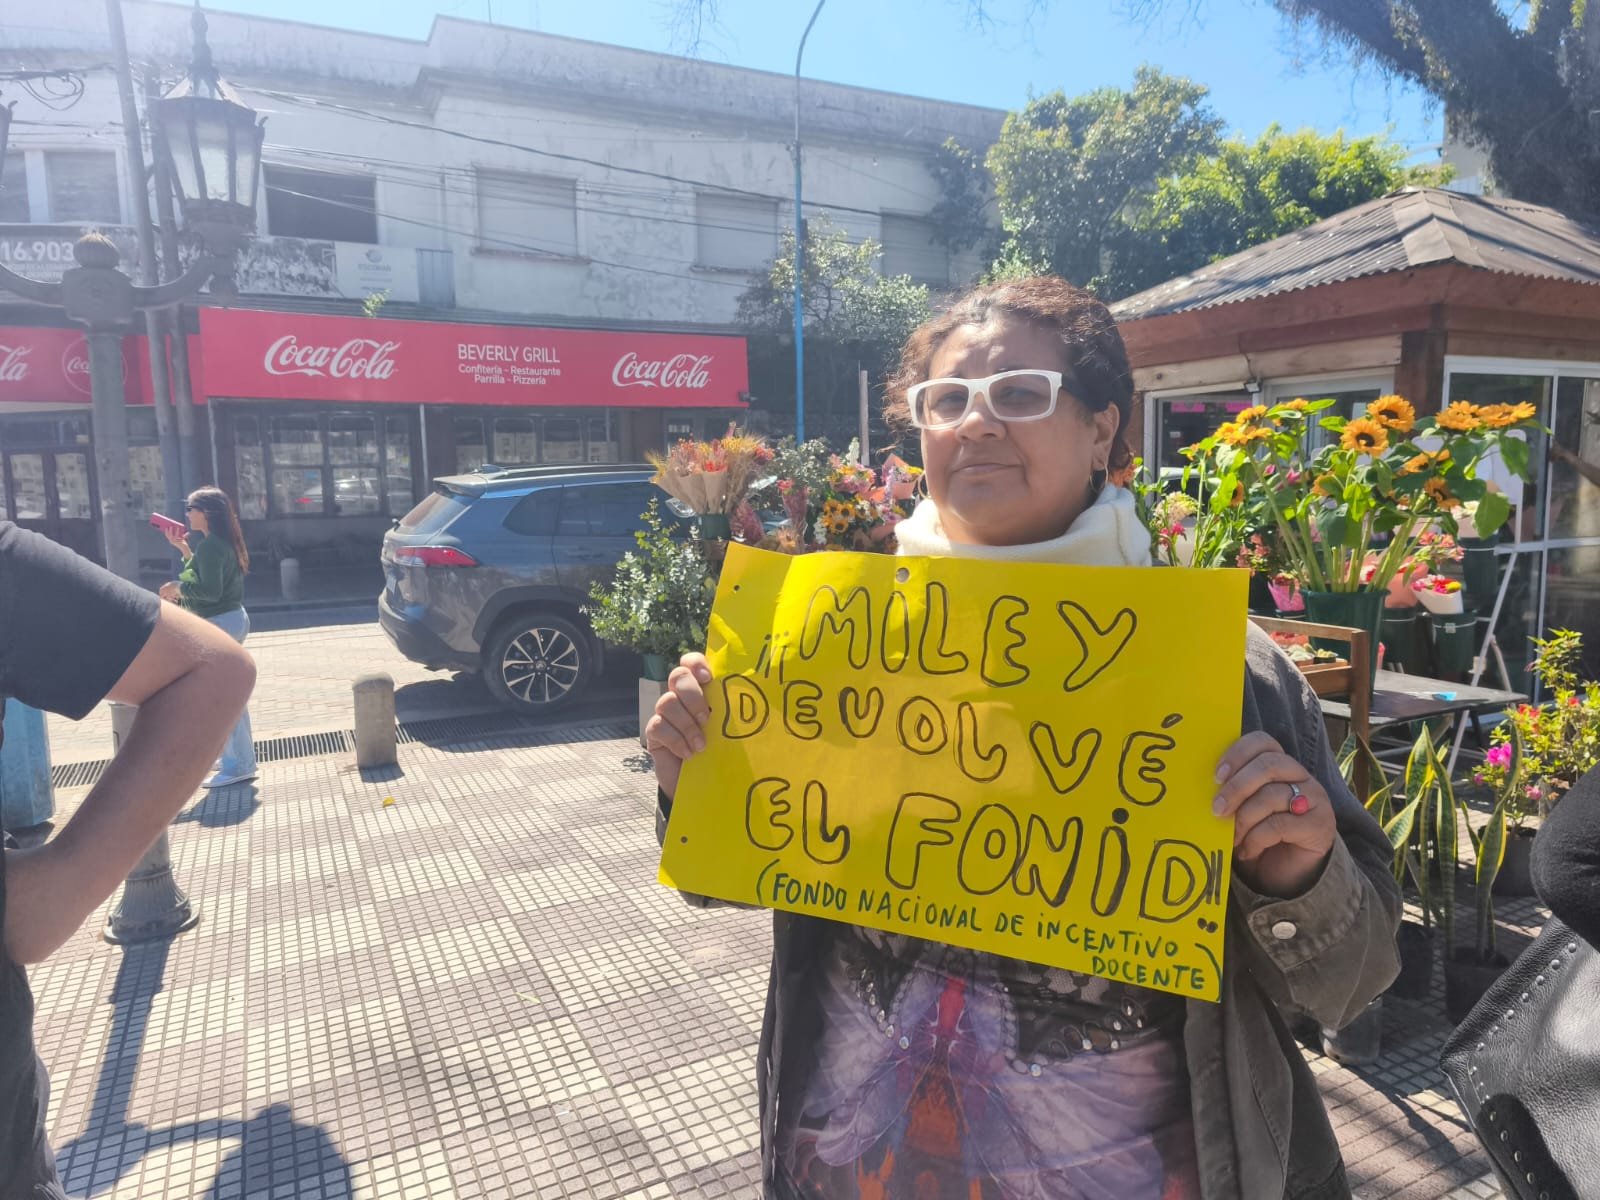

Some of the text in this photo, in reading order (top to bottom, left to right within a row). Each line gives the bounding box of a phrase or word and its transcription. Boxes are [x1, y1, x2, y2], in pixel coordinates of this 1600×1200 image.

[264, 335, 402, 380] Coca-Cola
[458, 343, 560, 363] BEVERLY GRILL
[474, 374, 505, 384] Parrilla
[510, 366, 561, 377] Restaurante
[612, 352, 714, 388] Coca-Cola
[745, 776, 851, 865] EL
[995, 912, 1025, 936] DE
